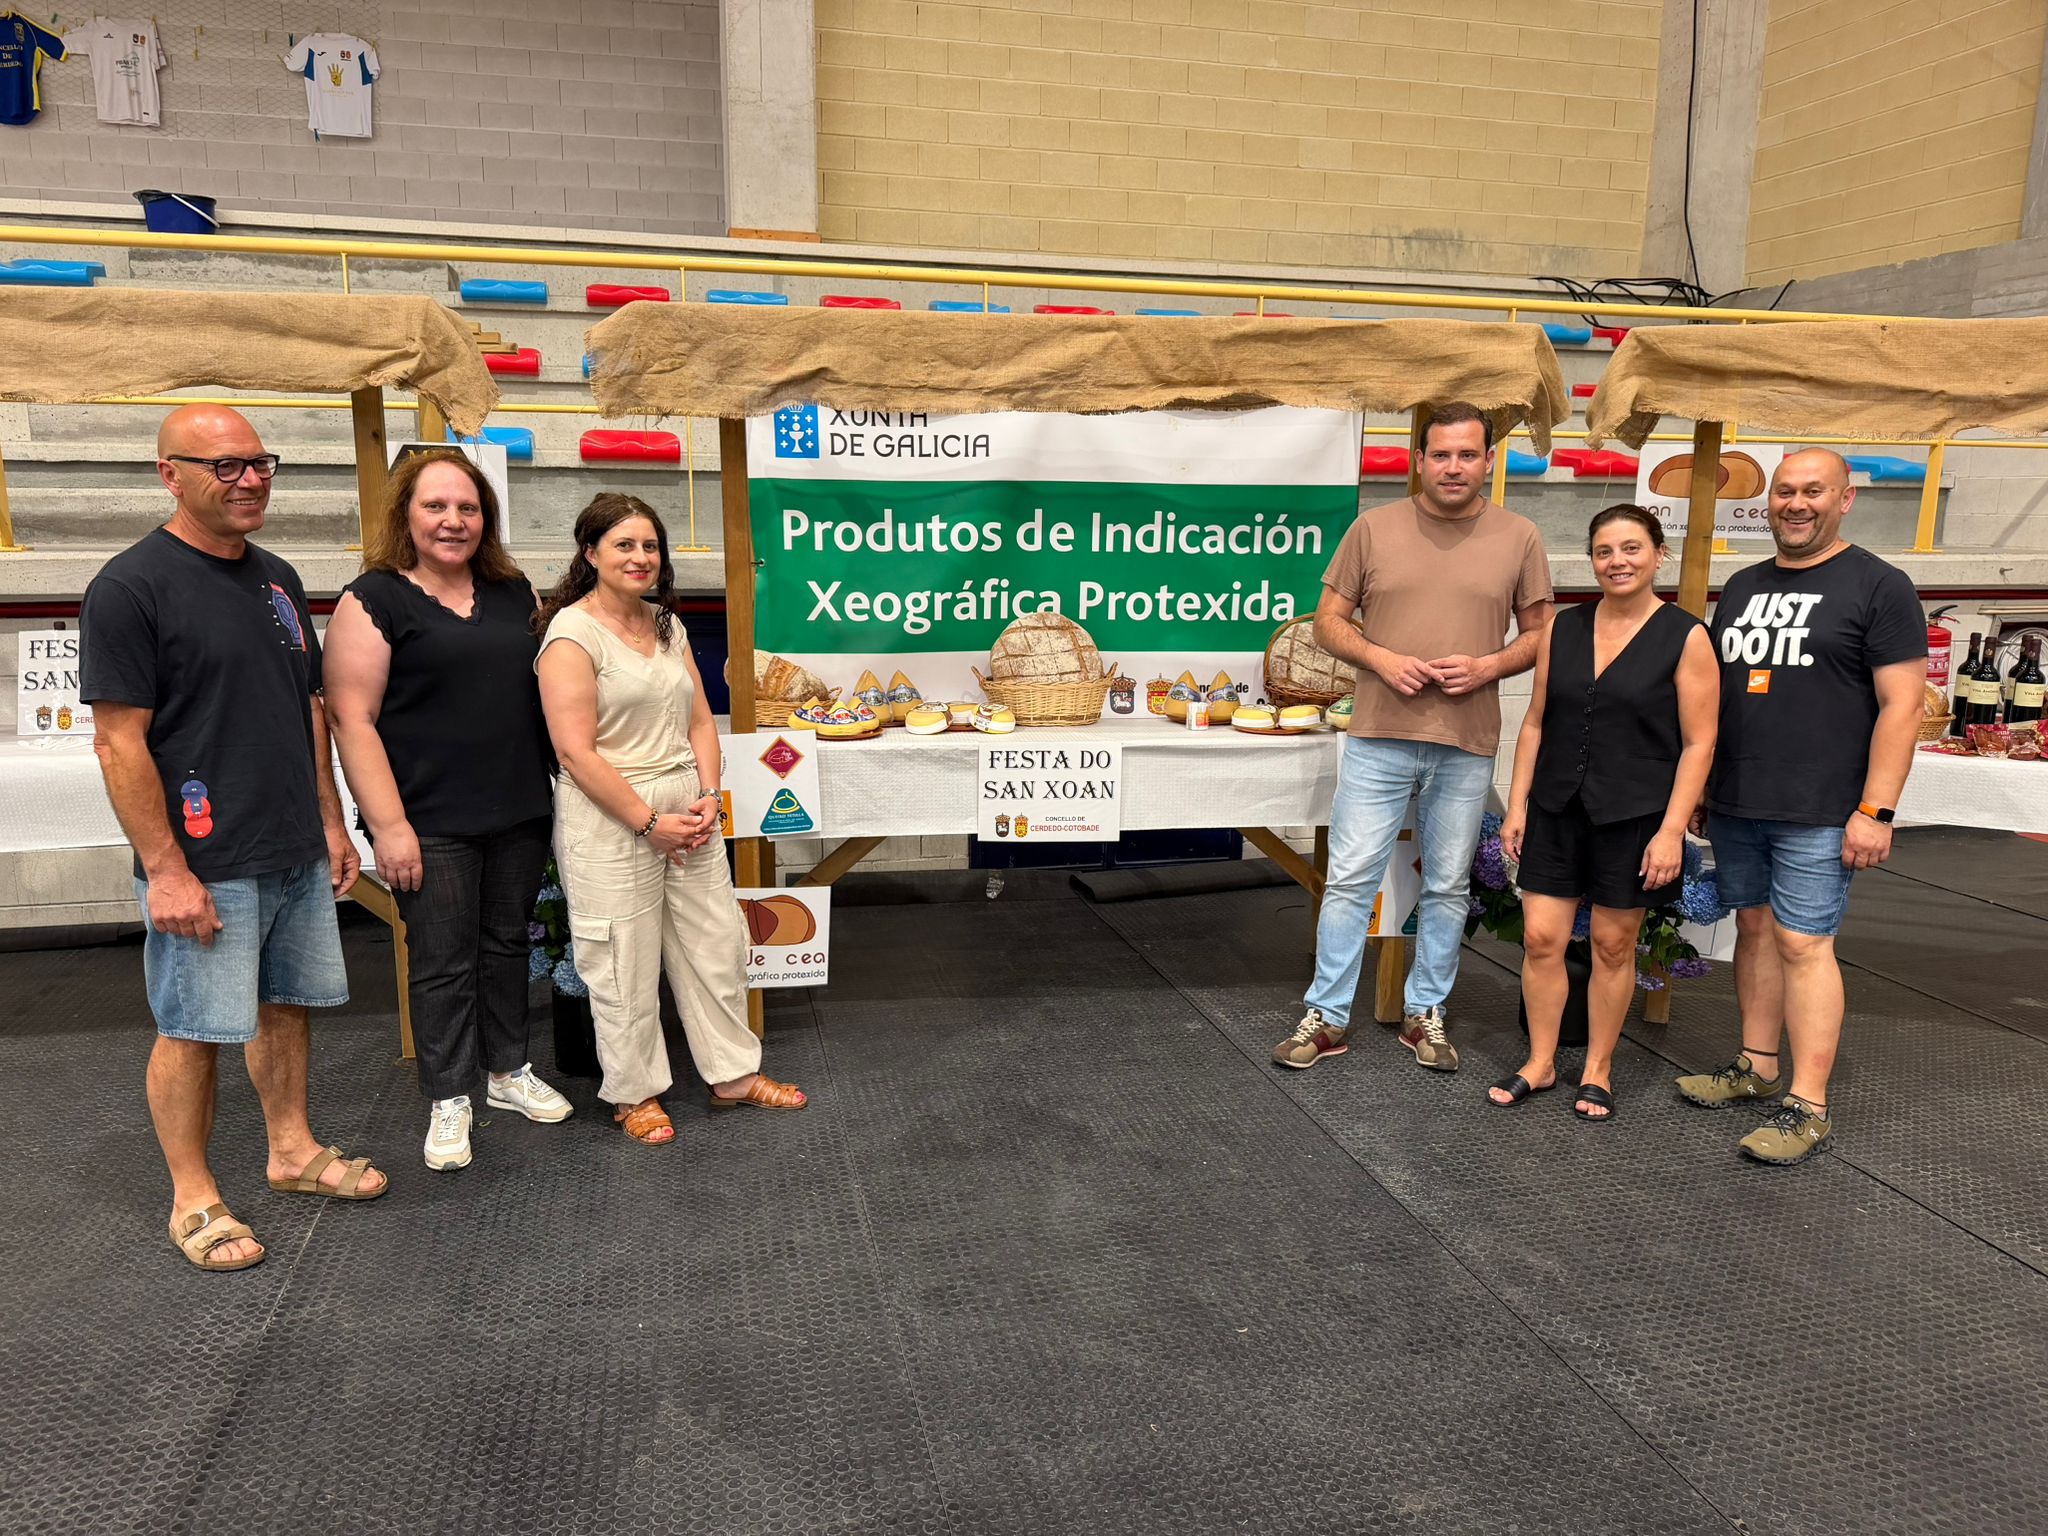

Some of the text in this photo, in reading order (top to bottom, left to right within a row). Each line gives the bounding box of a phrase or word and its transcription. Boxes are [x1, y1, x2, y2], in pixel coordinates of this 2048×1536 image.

[830, 433, 989, 458] DE GALICIA
[783, 508, 1322, 554] Produtos de Indicación
[806, 578, 1295, 635] Xeográfica Protexida
[1733, 592, 1823, 628] JUST
[29, 639, 78, 659] FES
[1721, 627, 1814, 666] DO IT.
[24, 670, 78, 690] SAN
[988, 750, 1111, 769] FESTA DO
[983, 780, 1115, 799] SAN XOAN
[786, 952, 825, 966] cea
[782, 969, 826, 981] protexida
